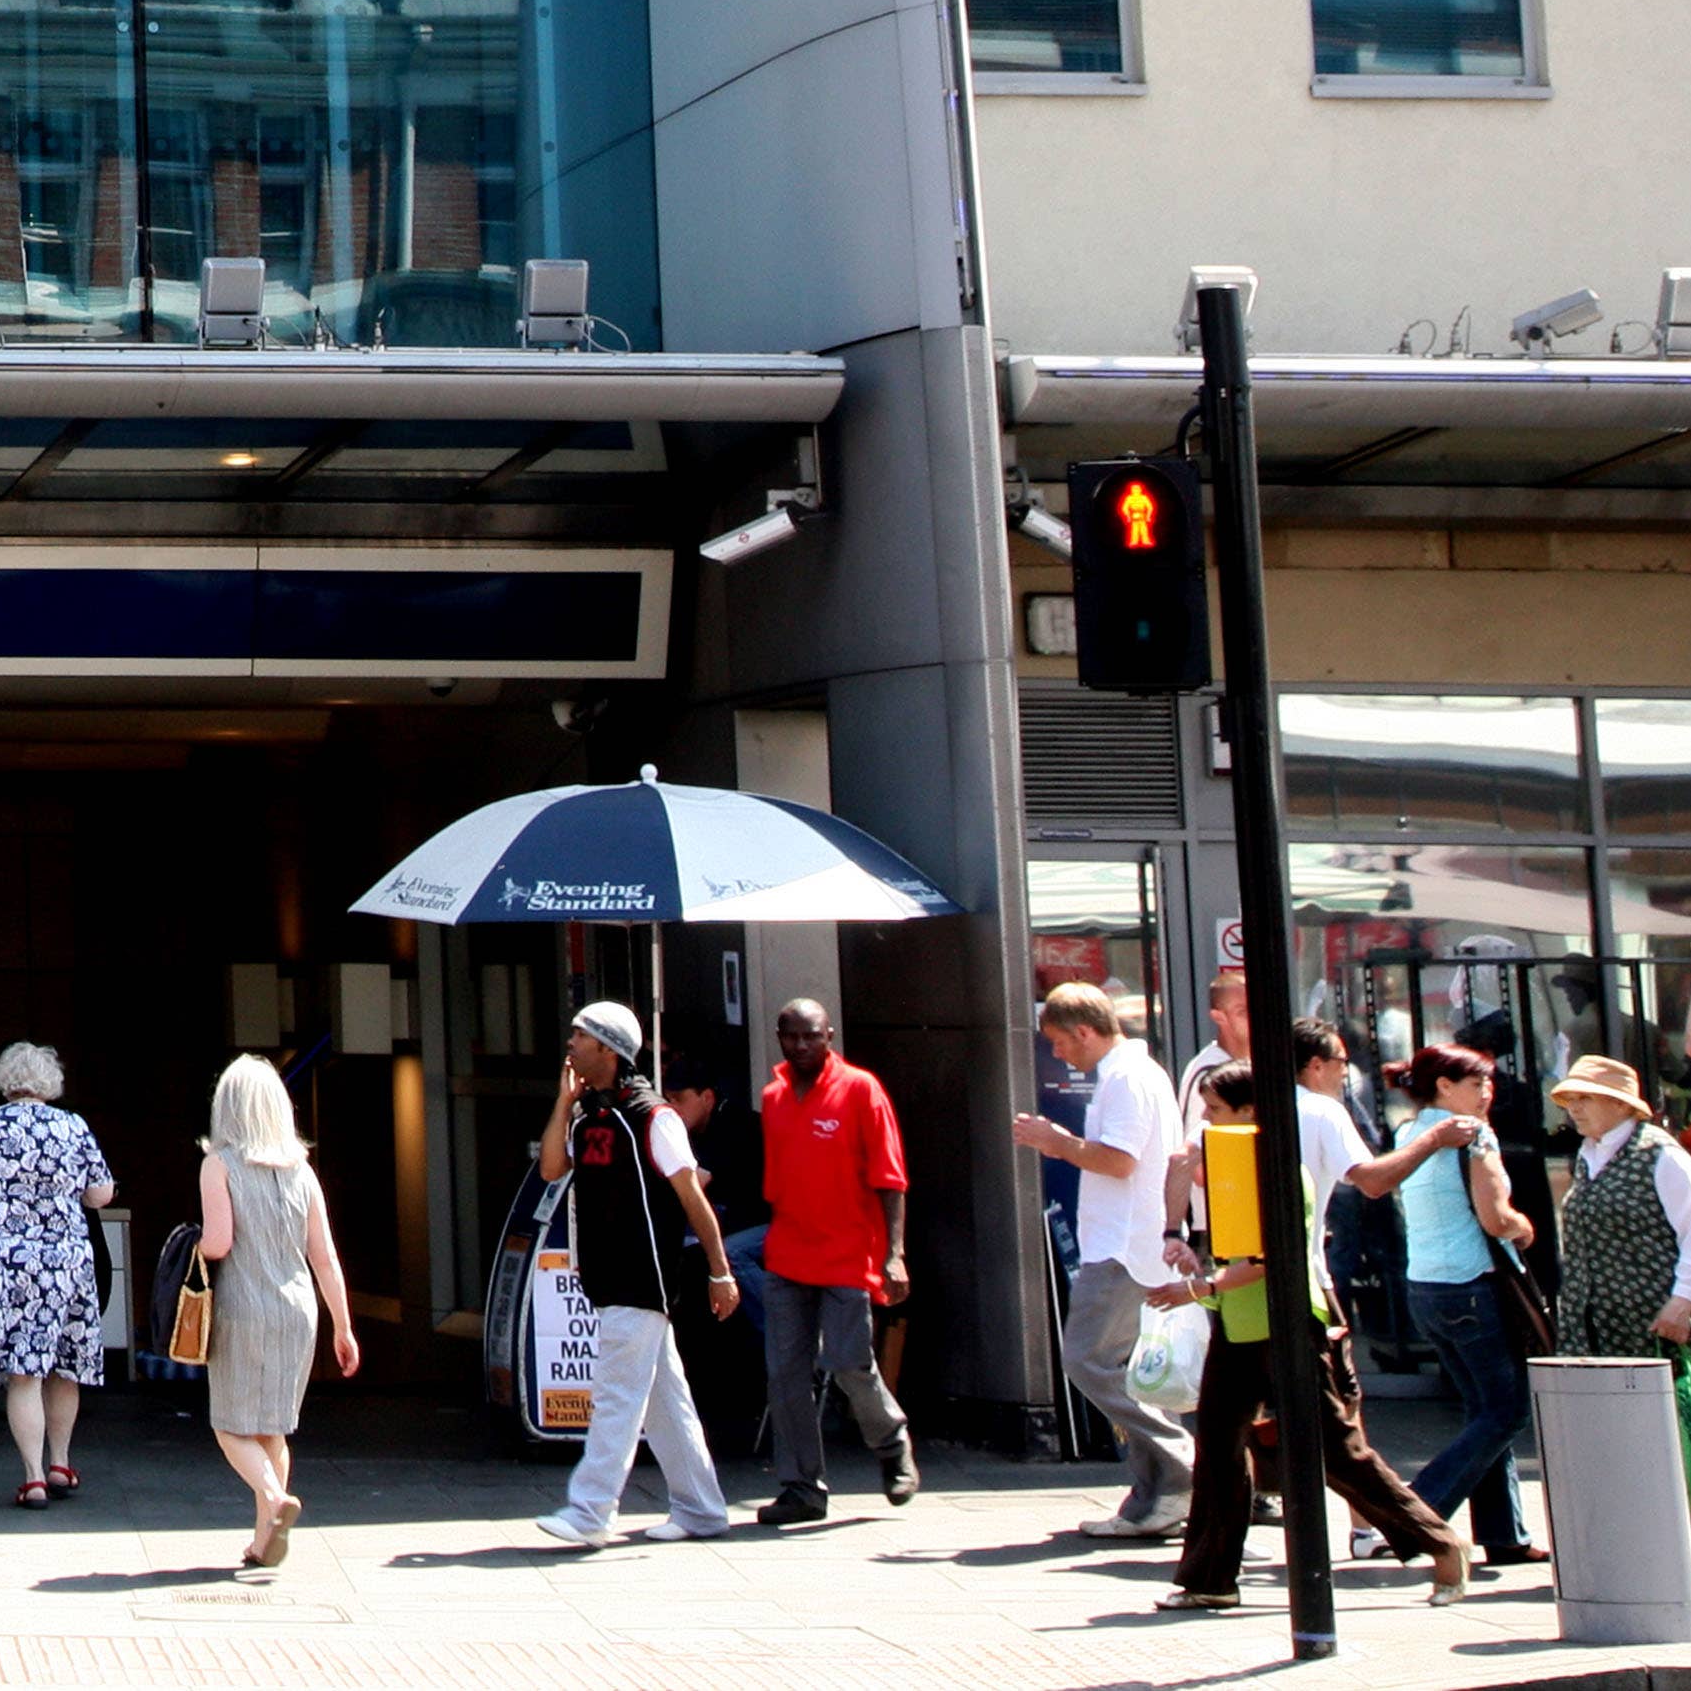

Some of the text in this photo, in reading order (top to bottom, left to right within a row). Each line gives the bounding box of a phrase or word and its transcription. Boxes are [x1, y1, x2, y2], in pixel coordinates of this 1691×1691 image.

[407, 877, 462, 899] Evening
[534, 880, 647, 897] Evening
[392, 892, 455, 911] Standard
[527, 894, 656, 910] Standard
[556, 1275, 583, 1294] BR
[569, 1318, 600, 1338] OV
[561, 1340, 598, 1359] MA
[550, 1362, 594, 1381] RAIL
[545, 1396, 595, 1410] Evenin
[545, 1409, 592, 1423] Stand
